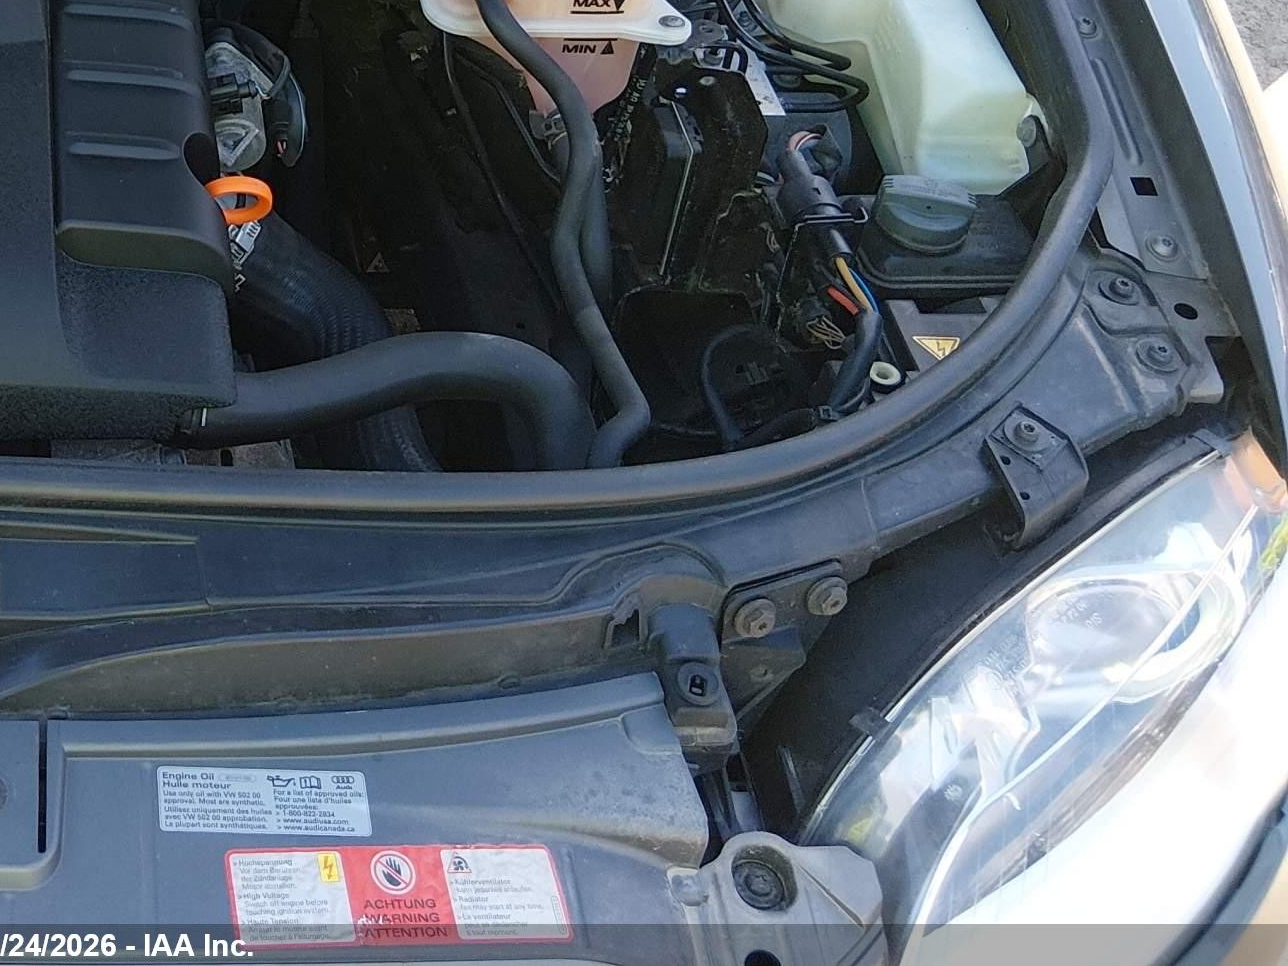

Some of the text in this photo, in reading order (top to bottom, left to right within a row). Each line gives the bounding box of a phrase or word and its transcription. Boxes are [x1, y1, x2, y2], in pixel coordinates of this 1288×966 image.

[562, 44, 597, 54] MIN
[162, 772, 198, 781] Engine
[162, 780, 189, 788] Huile
[178, 790, 193, 798] only
[314, 790, 348, 798] approved
[243, 893, 261, 901] High
[363, 898, 437, 910] ACHTUNG
[364, 912, 441, 924] WARNING
[364, 926, 449, 939] ATTENTION
